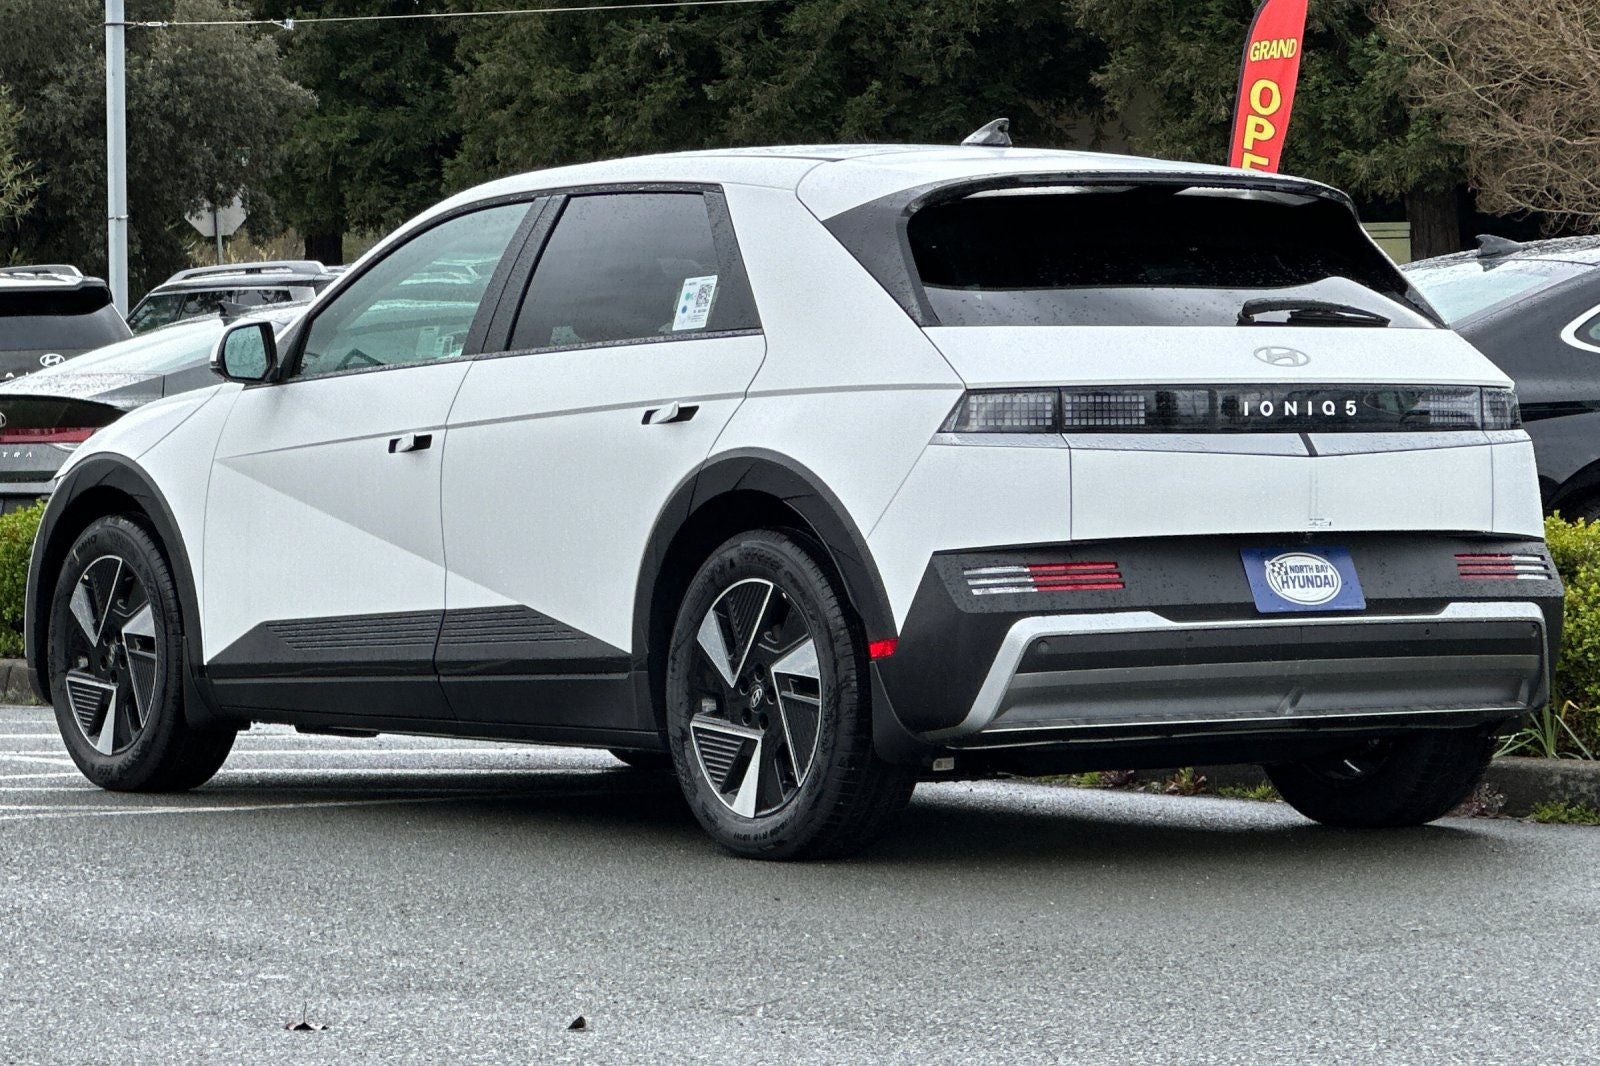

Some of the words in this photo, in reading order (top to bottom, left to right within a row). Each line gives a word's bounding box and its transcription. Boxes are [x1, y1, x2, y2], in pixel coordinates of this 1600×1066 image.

[1249, 38, 1298, 62] GRAND
[1243, 400, 1336, 417] IONIQ
[1345, 400, 1357, 416] 5
[1289, 564, 1313, 574] NORTH
[1315, 564, 1329, 574] BAY
[1280, 575, 1335, 589] HYUNDAI
